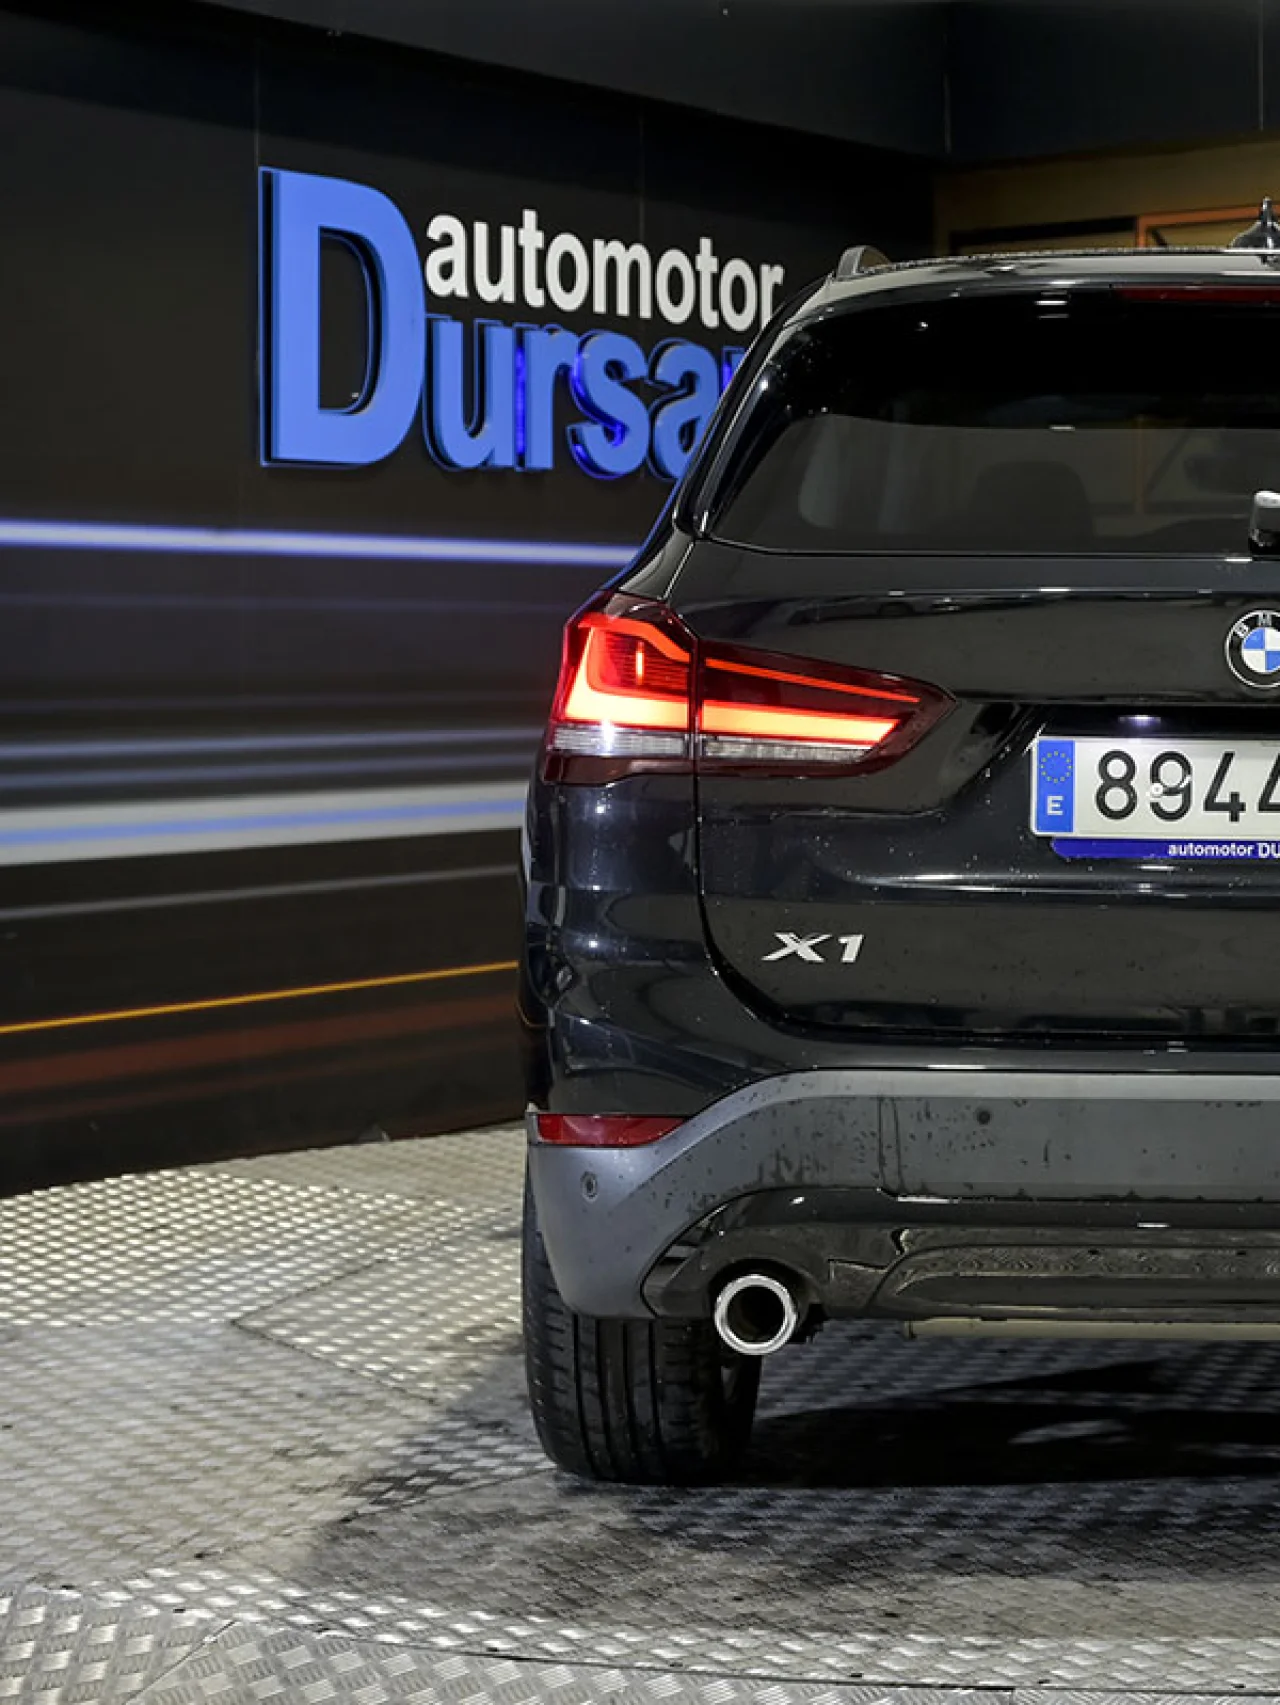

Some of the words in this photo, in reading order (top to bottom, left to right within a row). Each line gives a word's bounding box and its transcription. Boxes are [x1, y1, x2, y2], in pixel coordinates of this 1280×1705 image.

[426, 208, 785, 331] automotor
[258, 166, 759, 480] Dursa
[1046, 796, 1063, 816] E
[1167, 843, 1254, 858] automotor
[761, 931, 864, 962] X1
